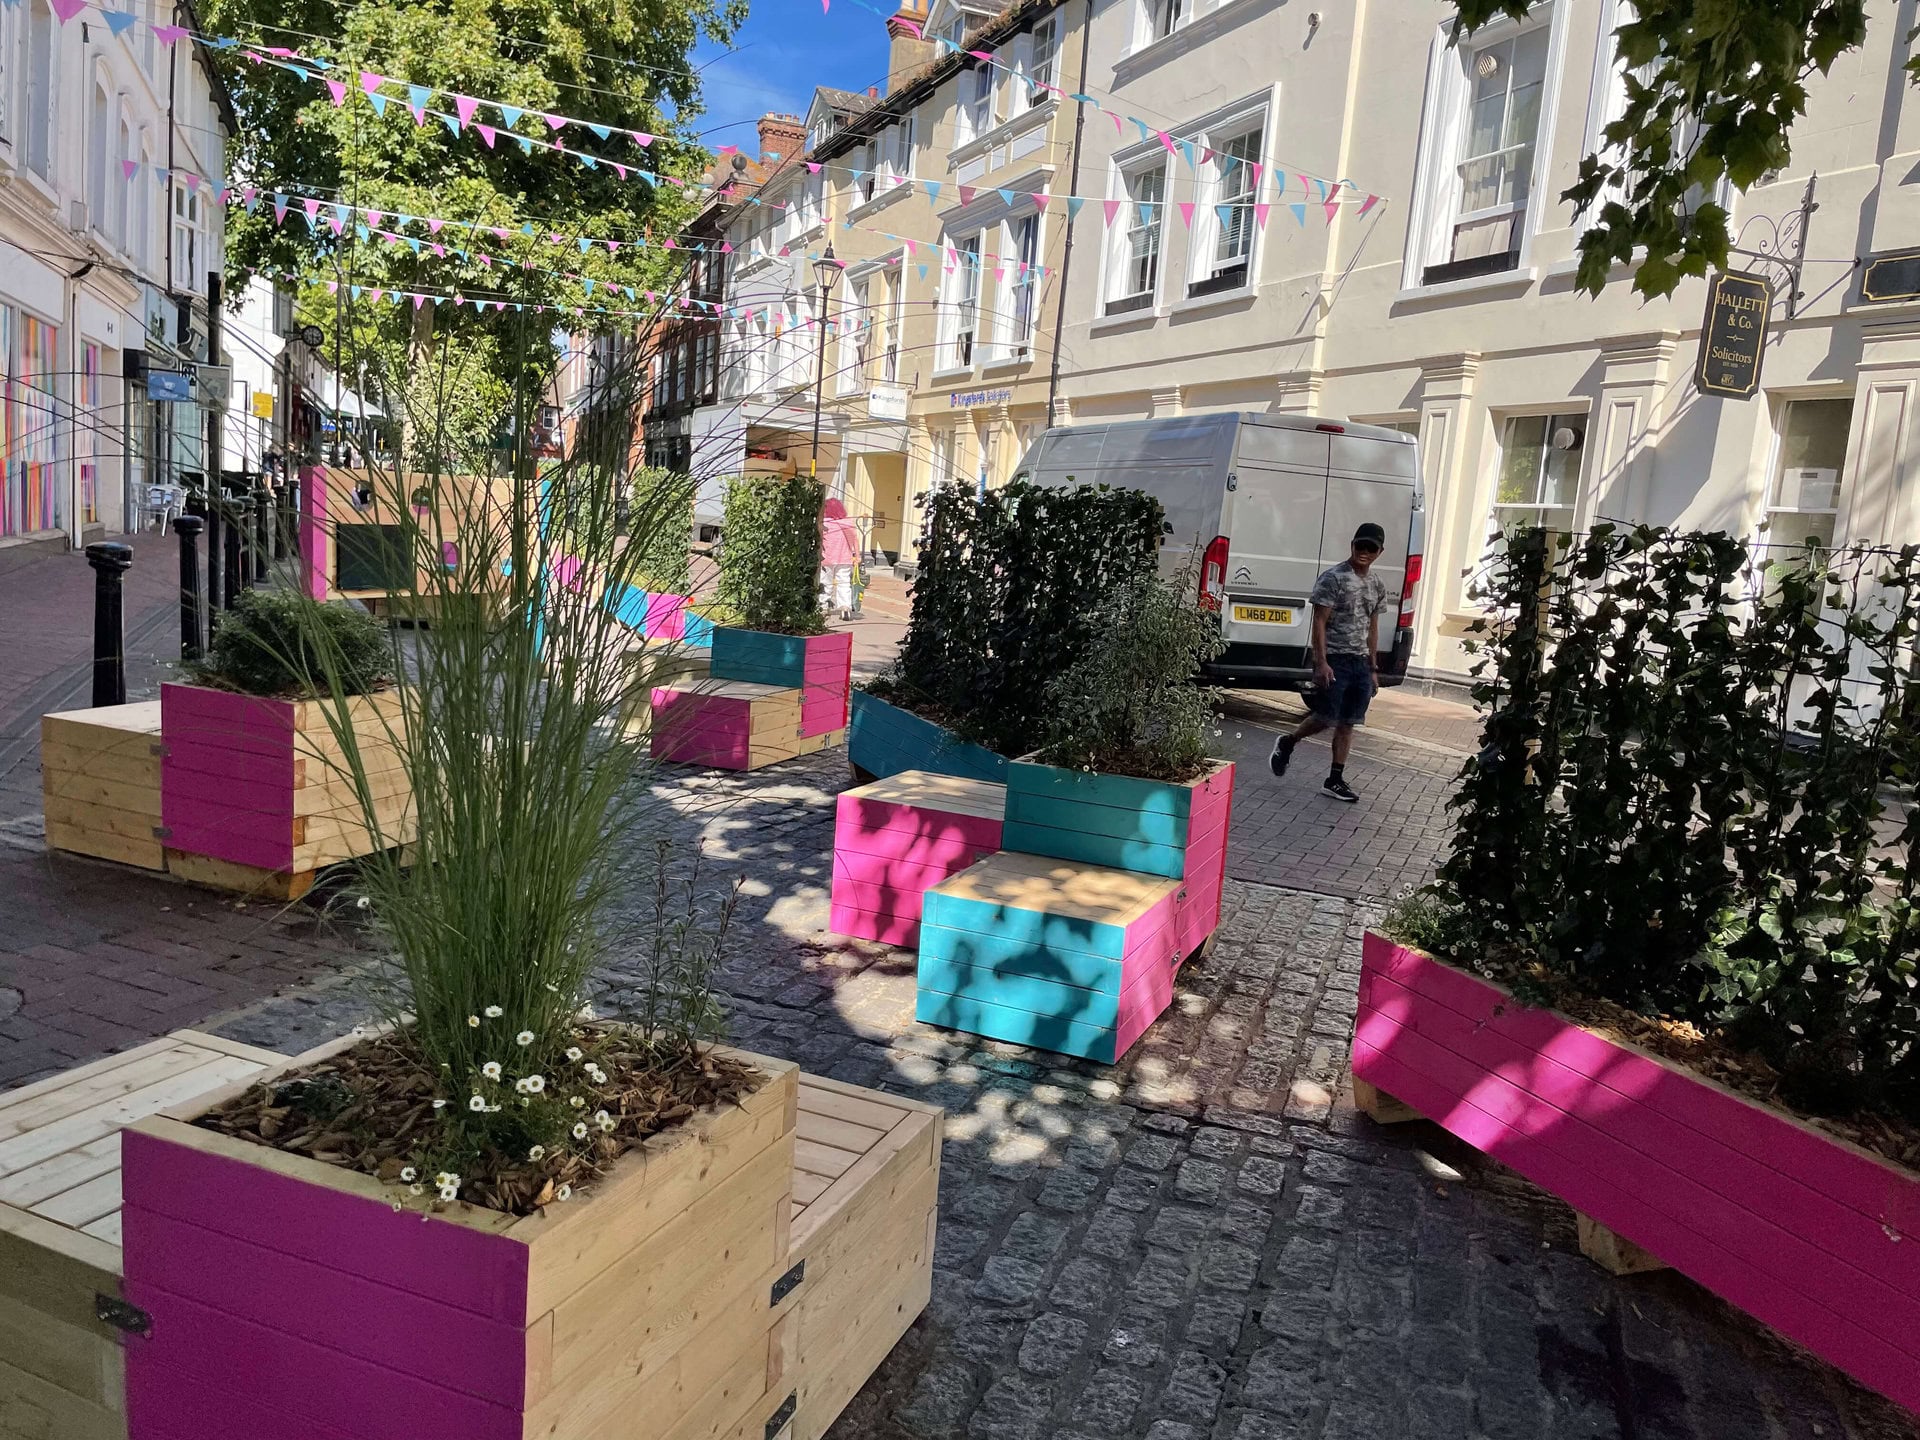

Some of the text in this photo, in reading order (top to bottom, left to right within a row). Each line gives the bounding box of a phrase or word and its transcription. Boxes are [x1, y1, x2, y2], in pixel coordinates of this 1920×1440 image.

[1716, 292, 1766, 312] HALLETT
[1728, 314, 1753, 329] & Co.
[1712, 345, 1752, 364] Solicitors
[1268, 610, 1287, 622] ZDG
